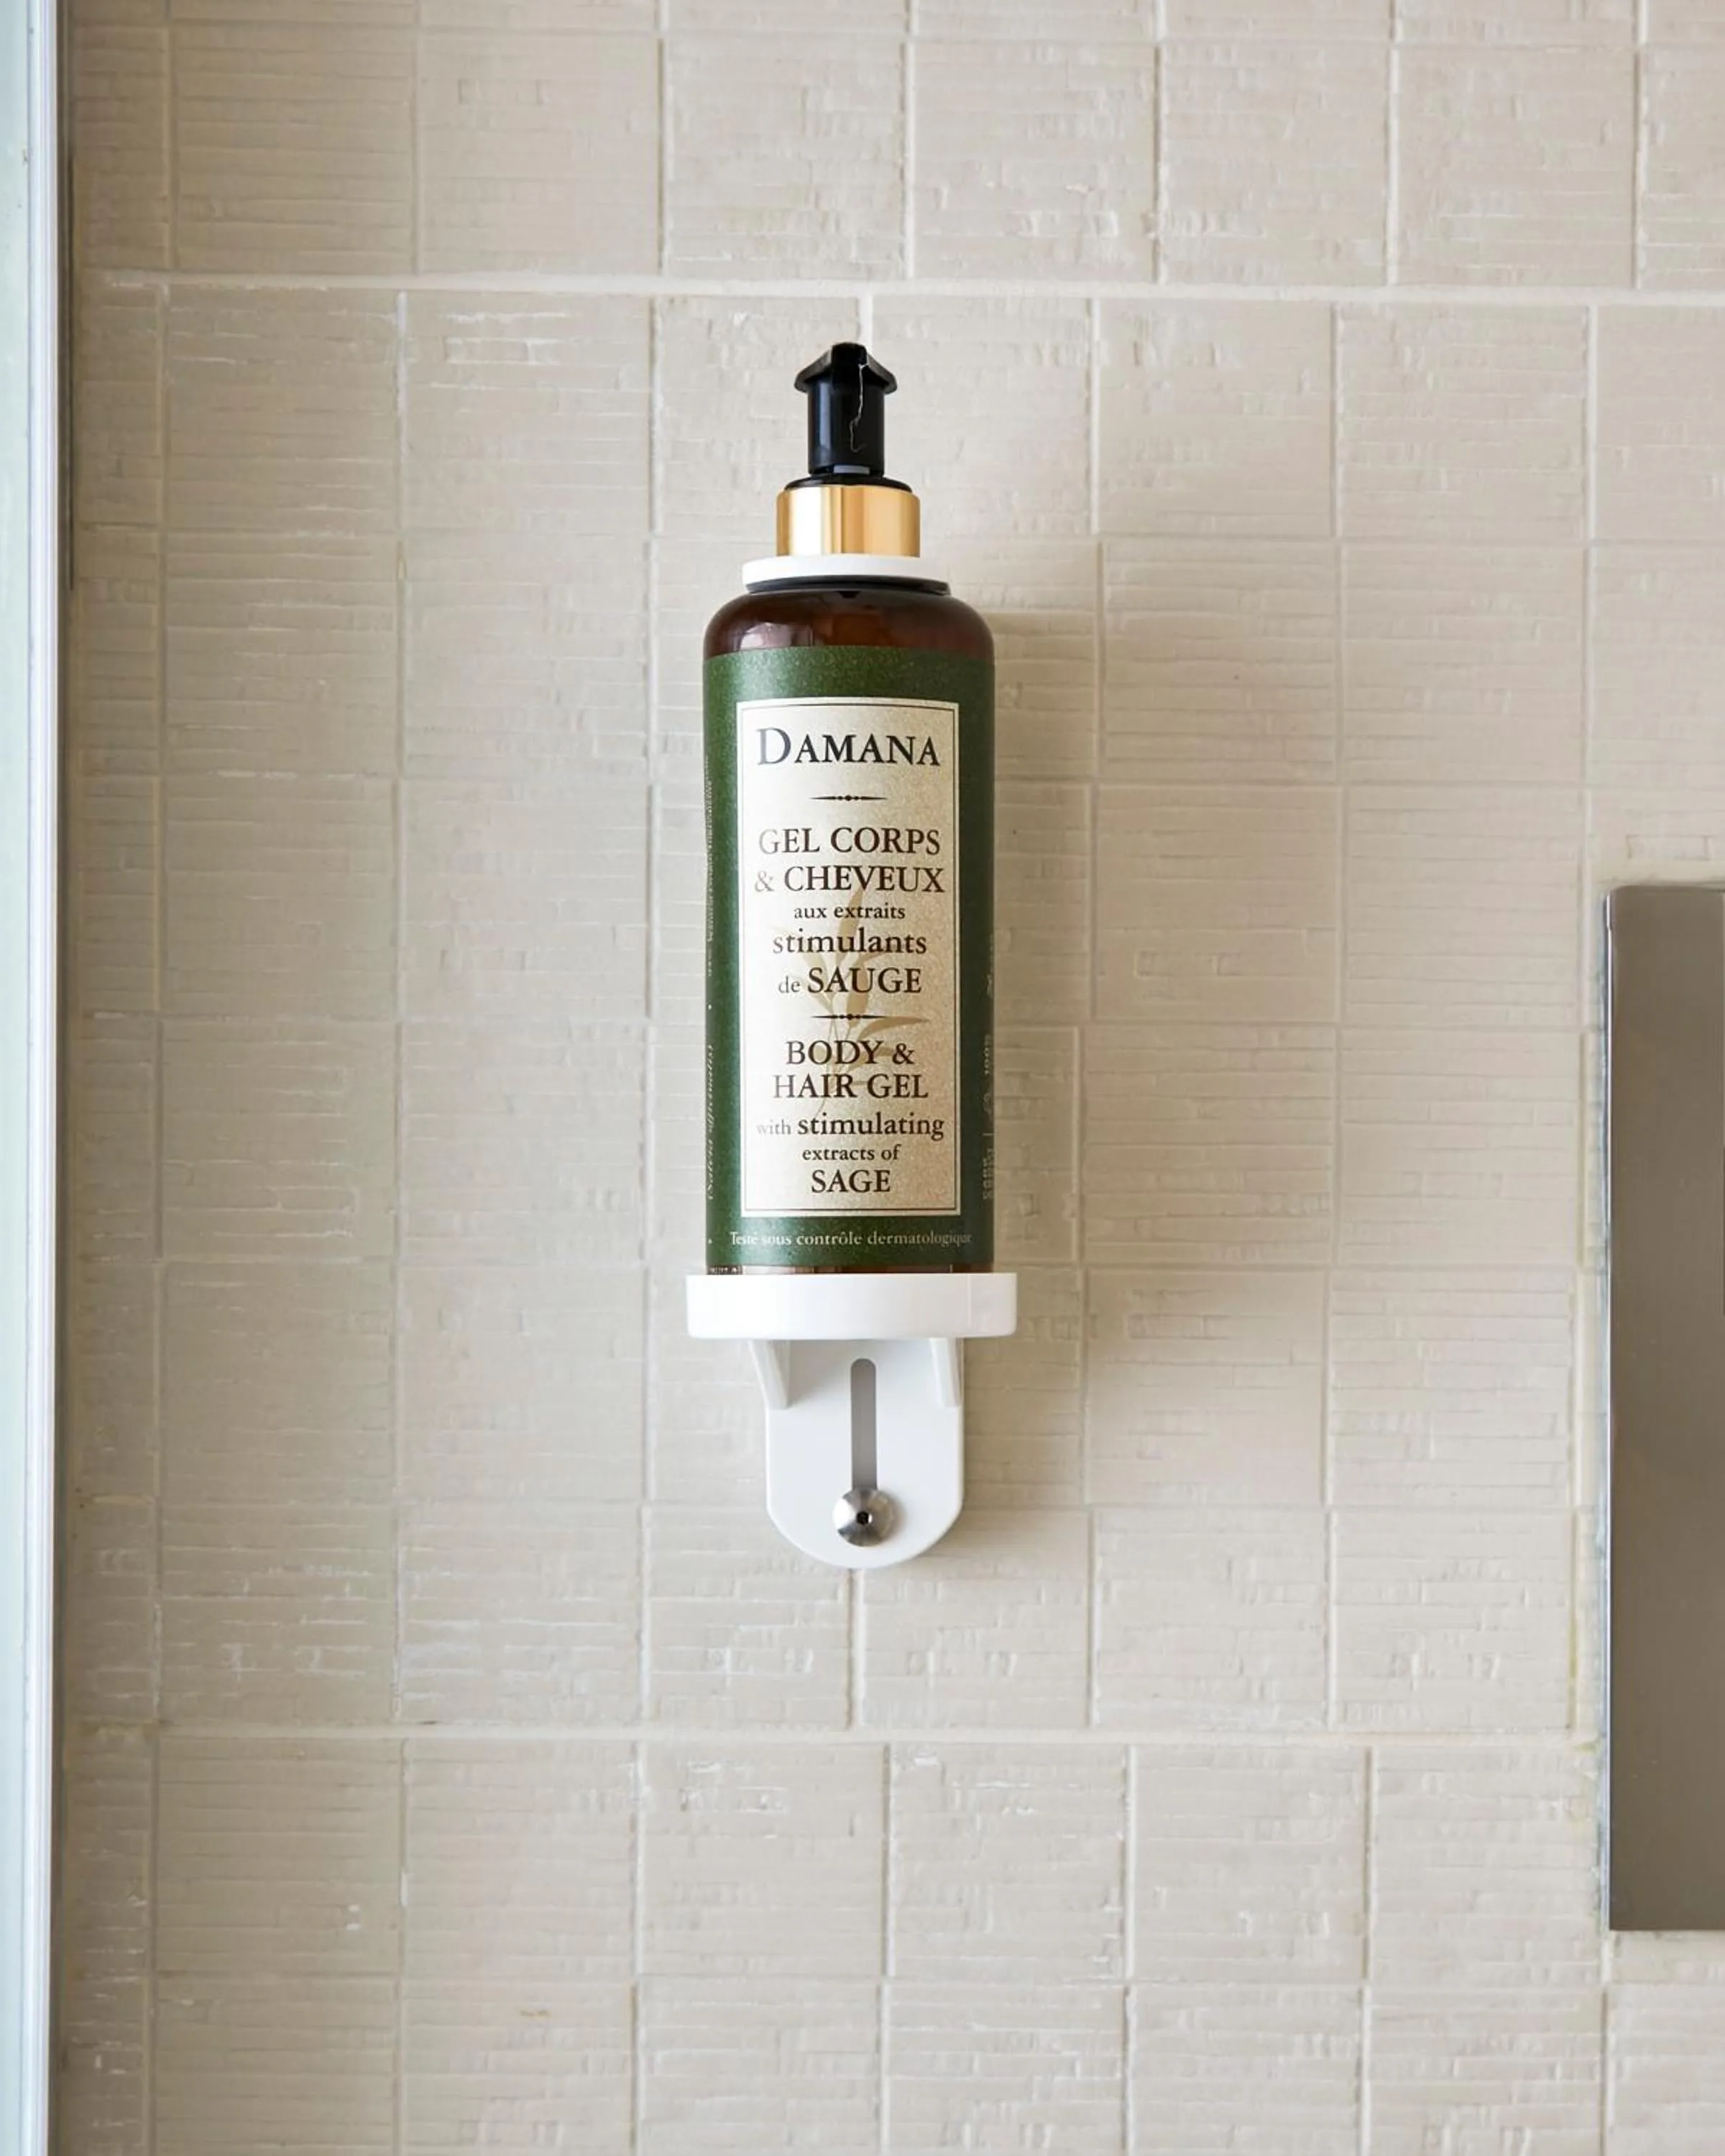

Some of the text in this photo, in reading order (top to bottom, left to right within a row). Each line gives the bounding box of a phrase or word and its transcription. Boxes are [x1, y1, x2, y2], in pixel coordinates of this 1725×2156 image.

[757, 727, 940, 767] DAMANA
[759, 827, 940, 855] GEL CORPS
[754, 865, 945, 893] & CHEVEUX
[794, 902, 906, 920] aux extraits
[773, 928, 927, 954] stimulants
[778, 967, 922, 994] de SAUGE
[786, 1039, 915, 1065] BODY &
[773, 1073, 929, 1100] HAIR GEL
[755, 1112, 945, 1141] with stimulating
[801, 1144, 901, 1161] extracts of
[811, 1169, 891, 1194] SAGE
[796, 1231, 862, 1245] contrôle
[867, 1230, 972, 1247] dermatologique
